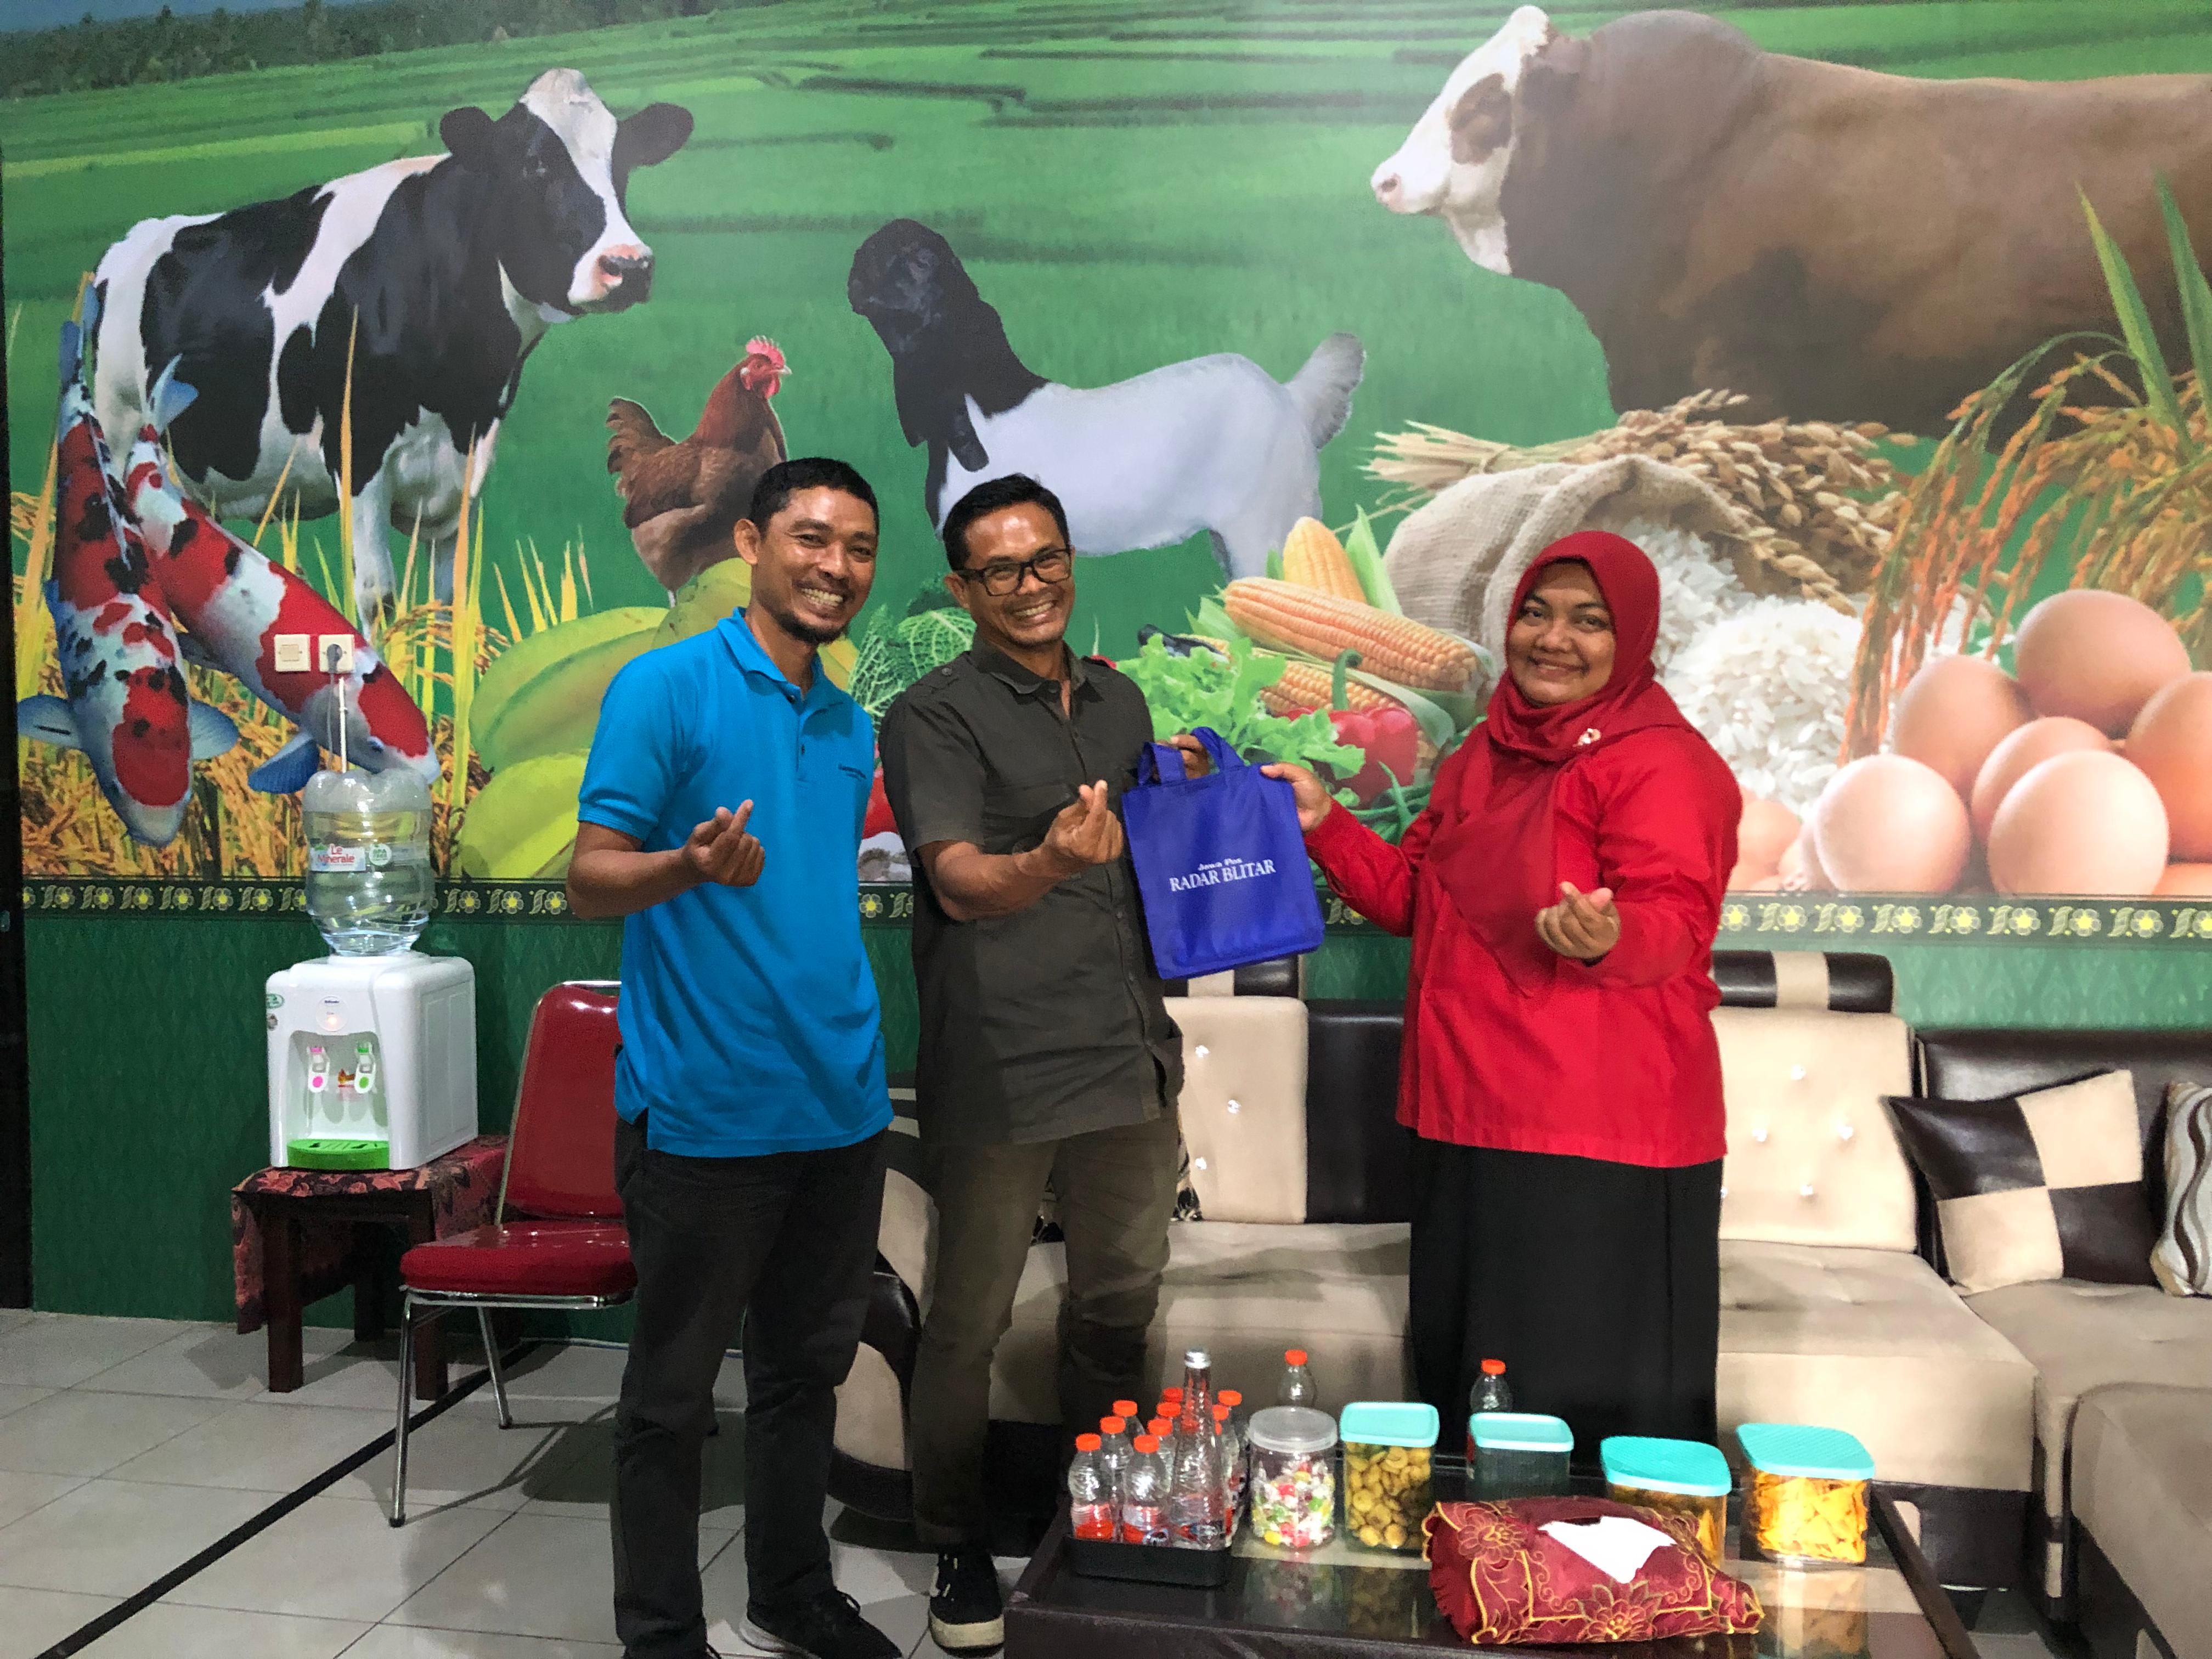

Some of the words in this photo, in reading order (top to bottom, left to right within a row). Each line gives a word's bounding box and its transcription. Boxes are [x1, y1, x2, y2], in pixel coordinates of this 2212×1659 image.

[330, 844, 342, 855] Le
[1170, 870, 1221, 891] RADAR
[1222, 859, 1276, 882] BLITAR
